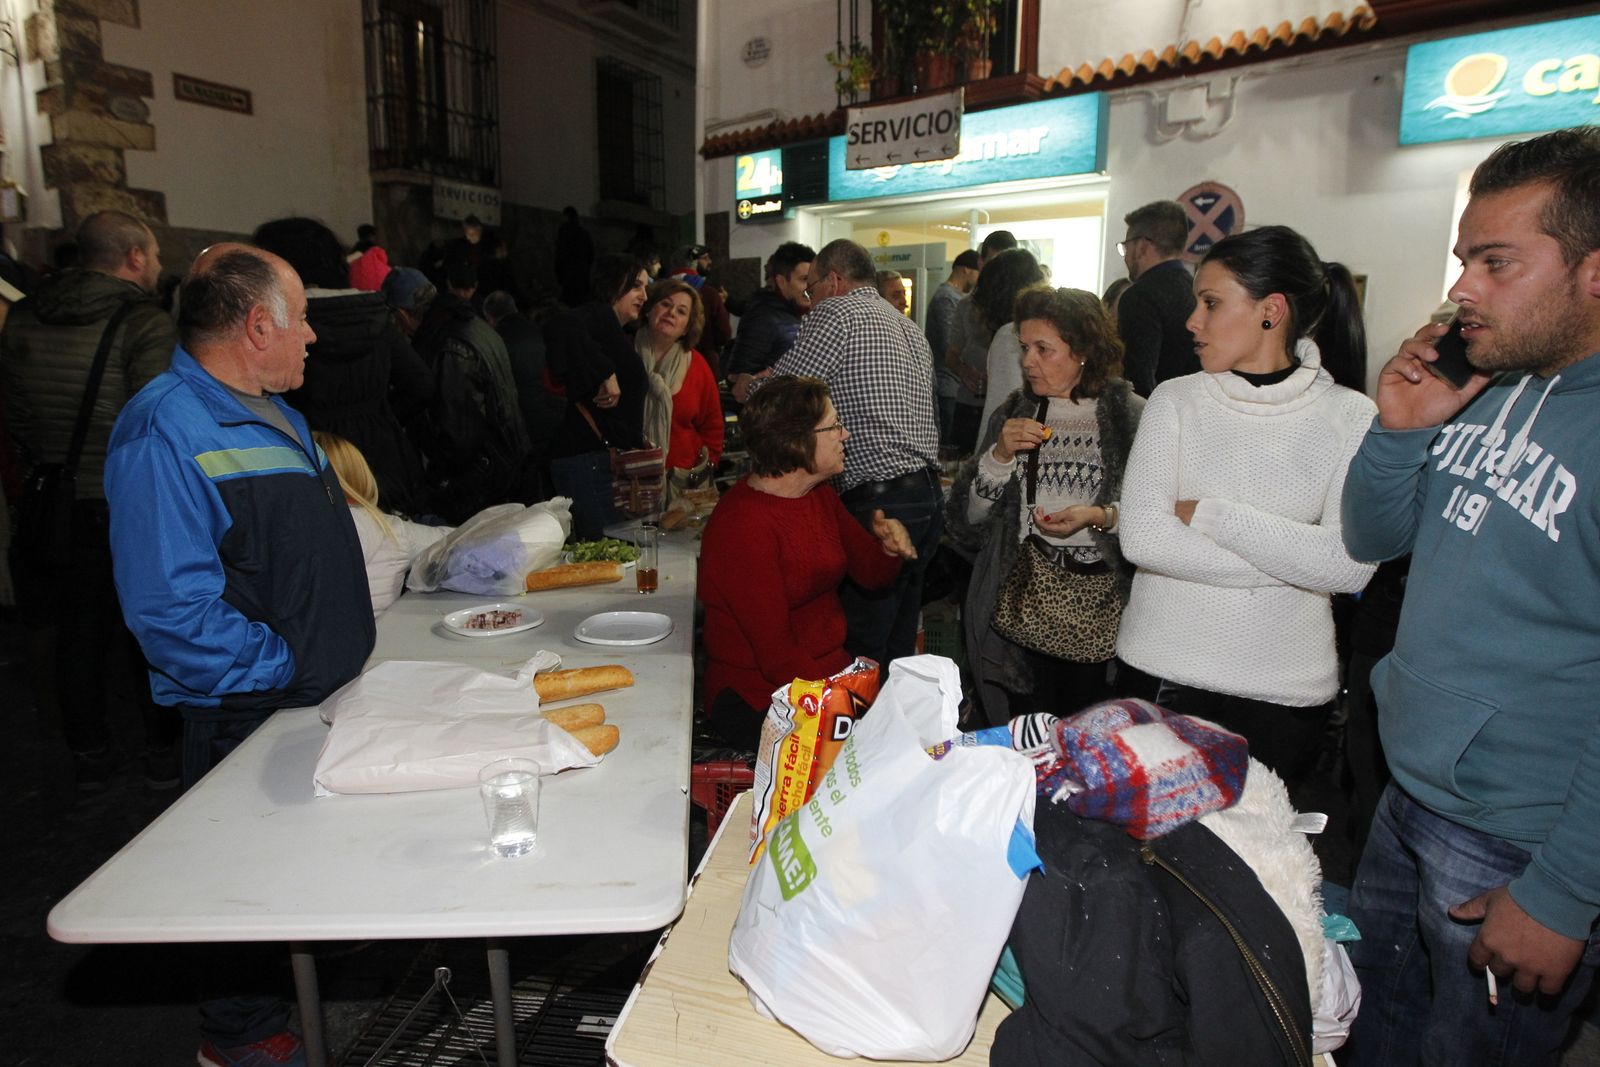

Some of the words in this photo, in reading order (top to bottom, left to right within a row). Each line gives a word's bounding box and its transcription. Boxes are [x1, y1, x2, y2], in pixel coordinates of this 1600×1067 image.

[1523, 53, 1600, 105] ca
[777, 775, 791, 821] ierra
[784, 733, 800, 771] fácil
[796, 744, 812, 776] fácil
[830, 790, 847, 806] el
[778, 822, 807, 891] AME!
